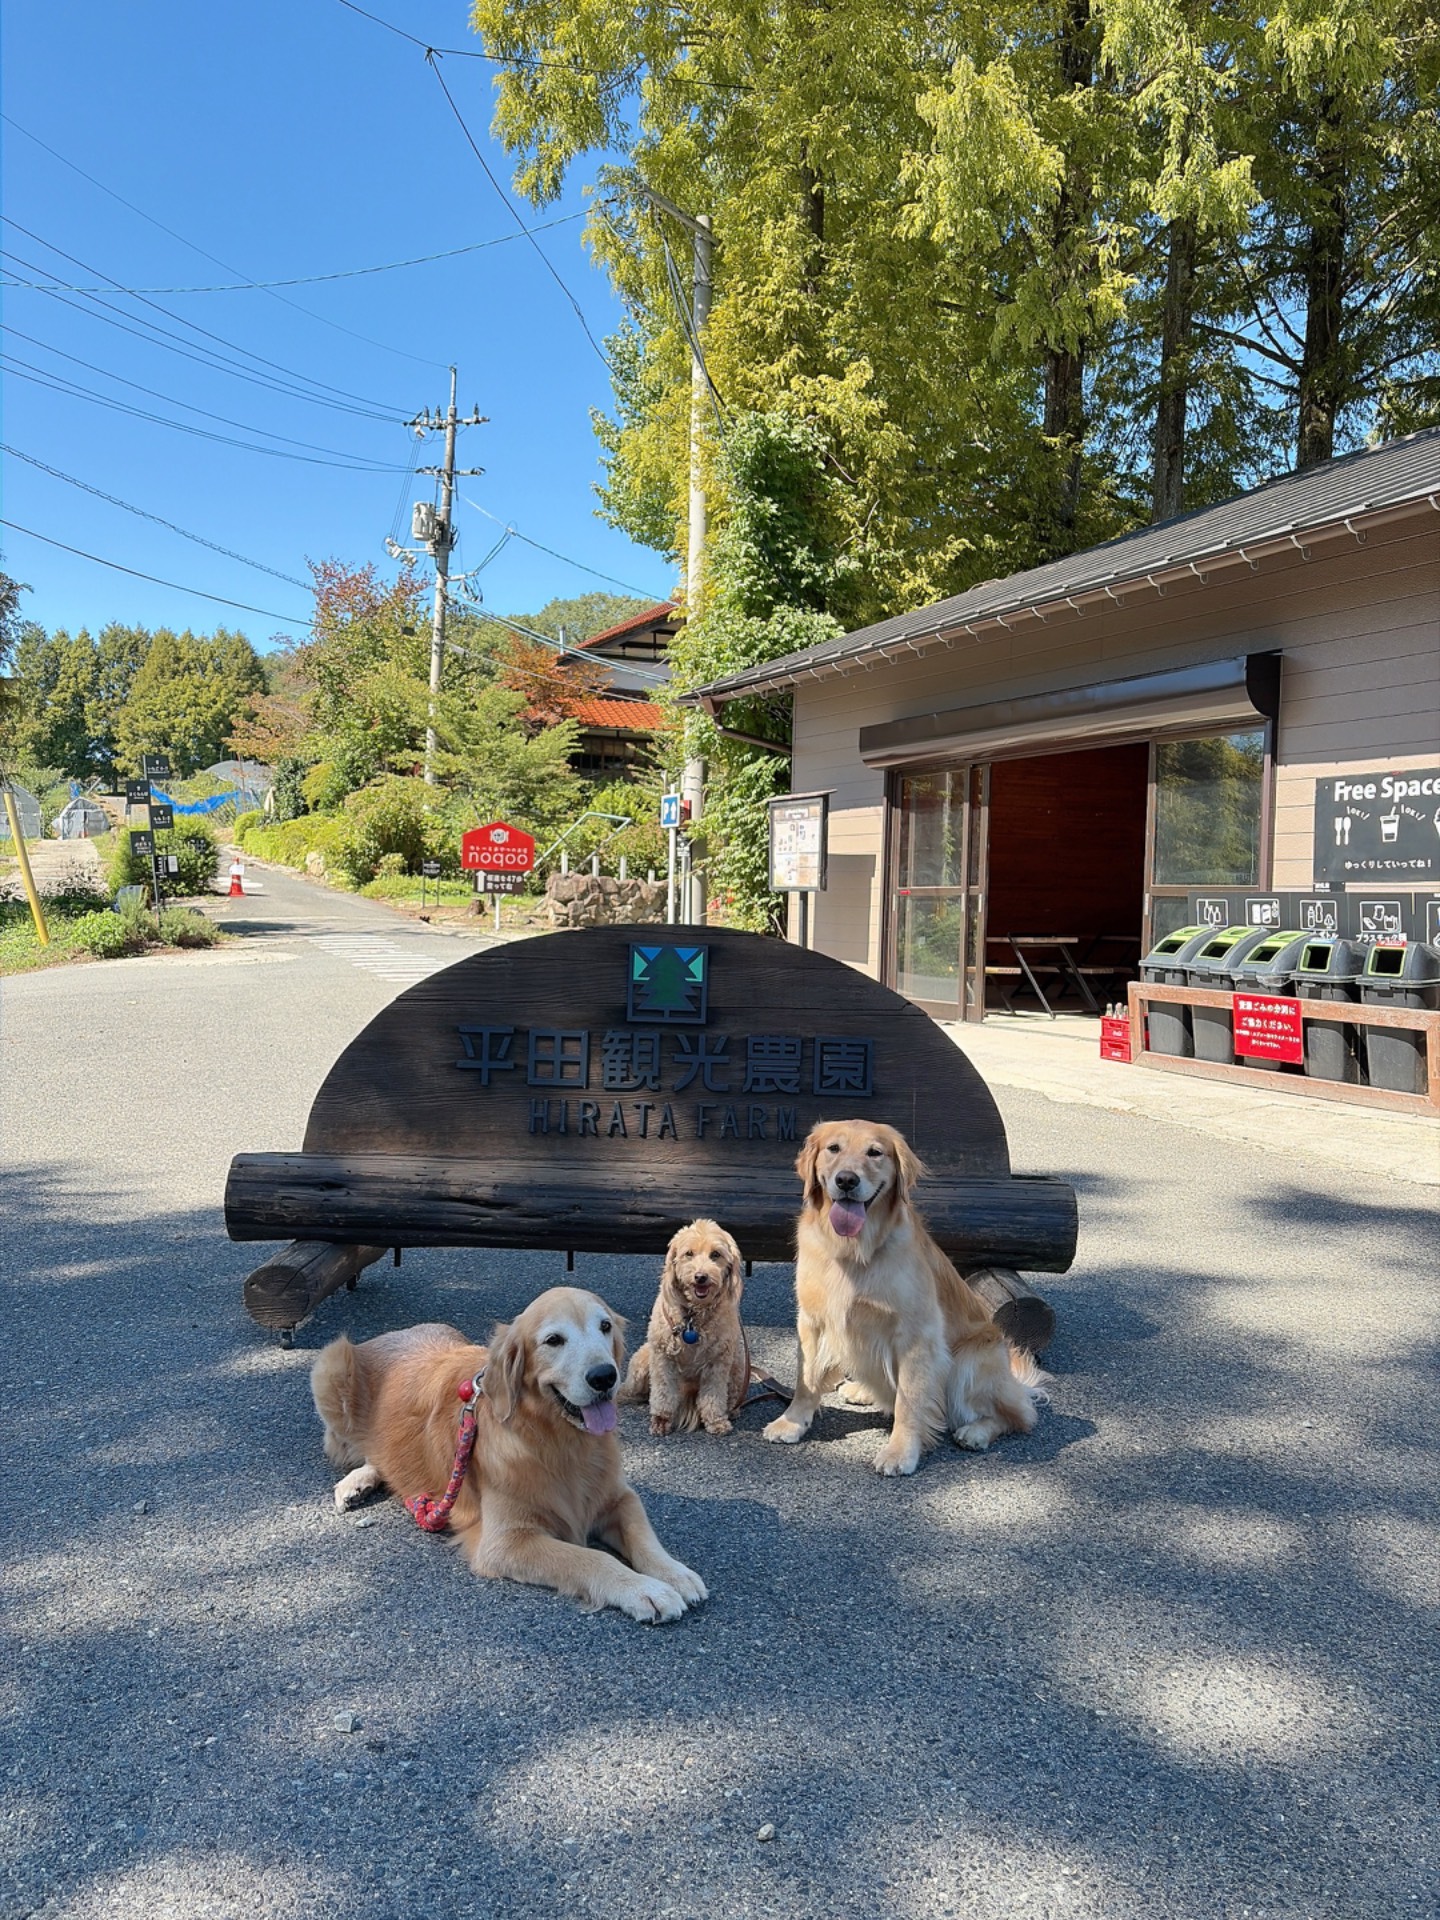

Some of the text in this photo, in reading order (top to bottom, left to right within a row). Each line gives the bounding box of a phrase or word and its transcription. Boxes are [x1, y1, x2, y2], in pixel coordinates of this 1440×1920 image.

[1334, 776, 1440, 804] Free Space
[468, 851, 528, 868] noqoo
[456, 1025, 873, 1097] 平田観光農園
[529, 1099, 797, 1141] HIRATA FARM
